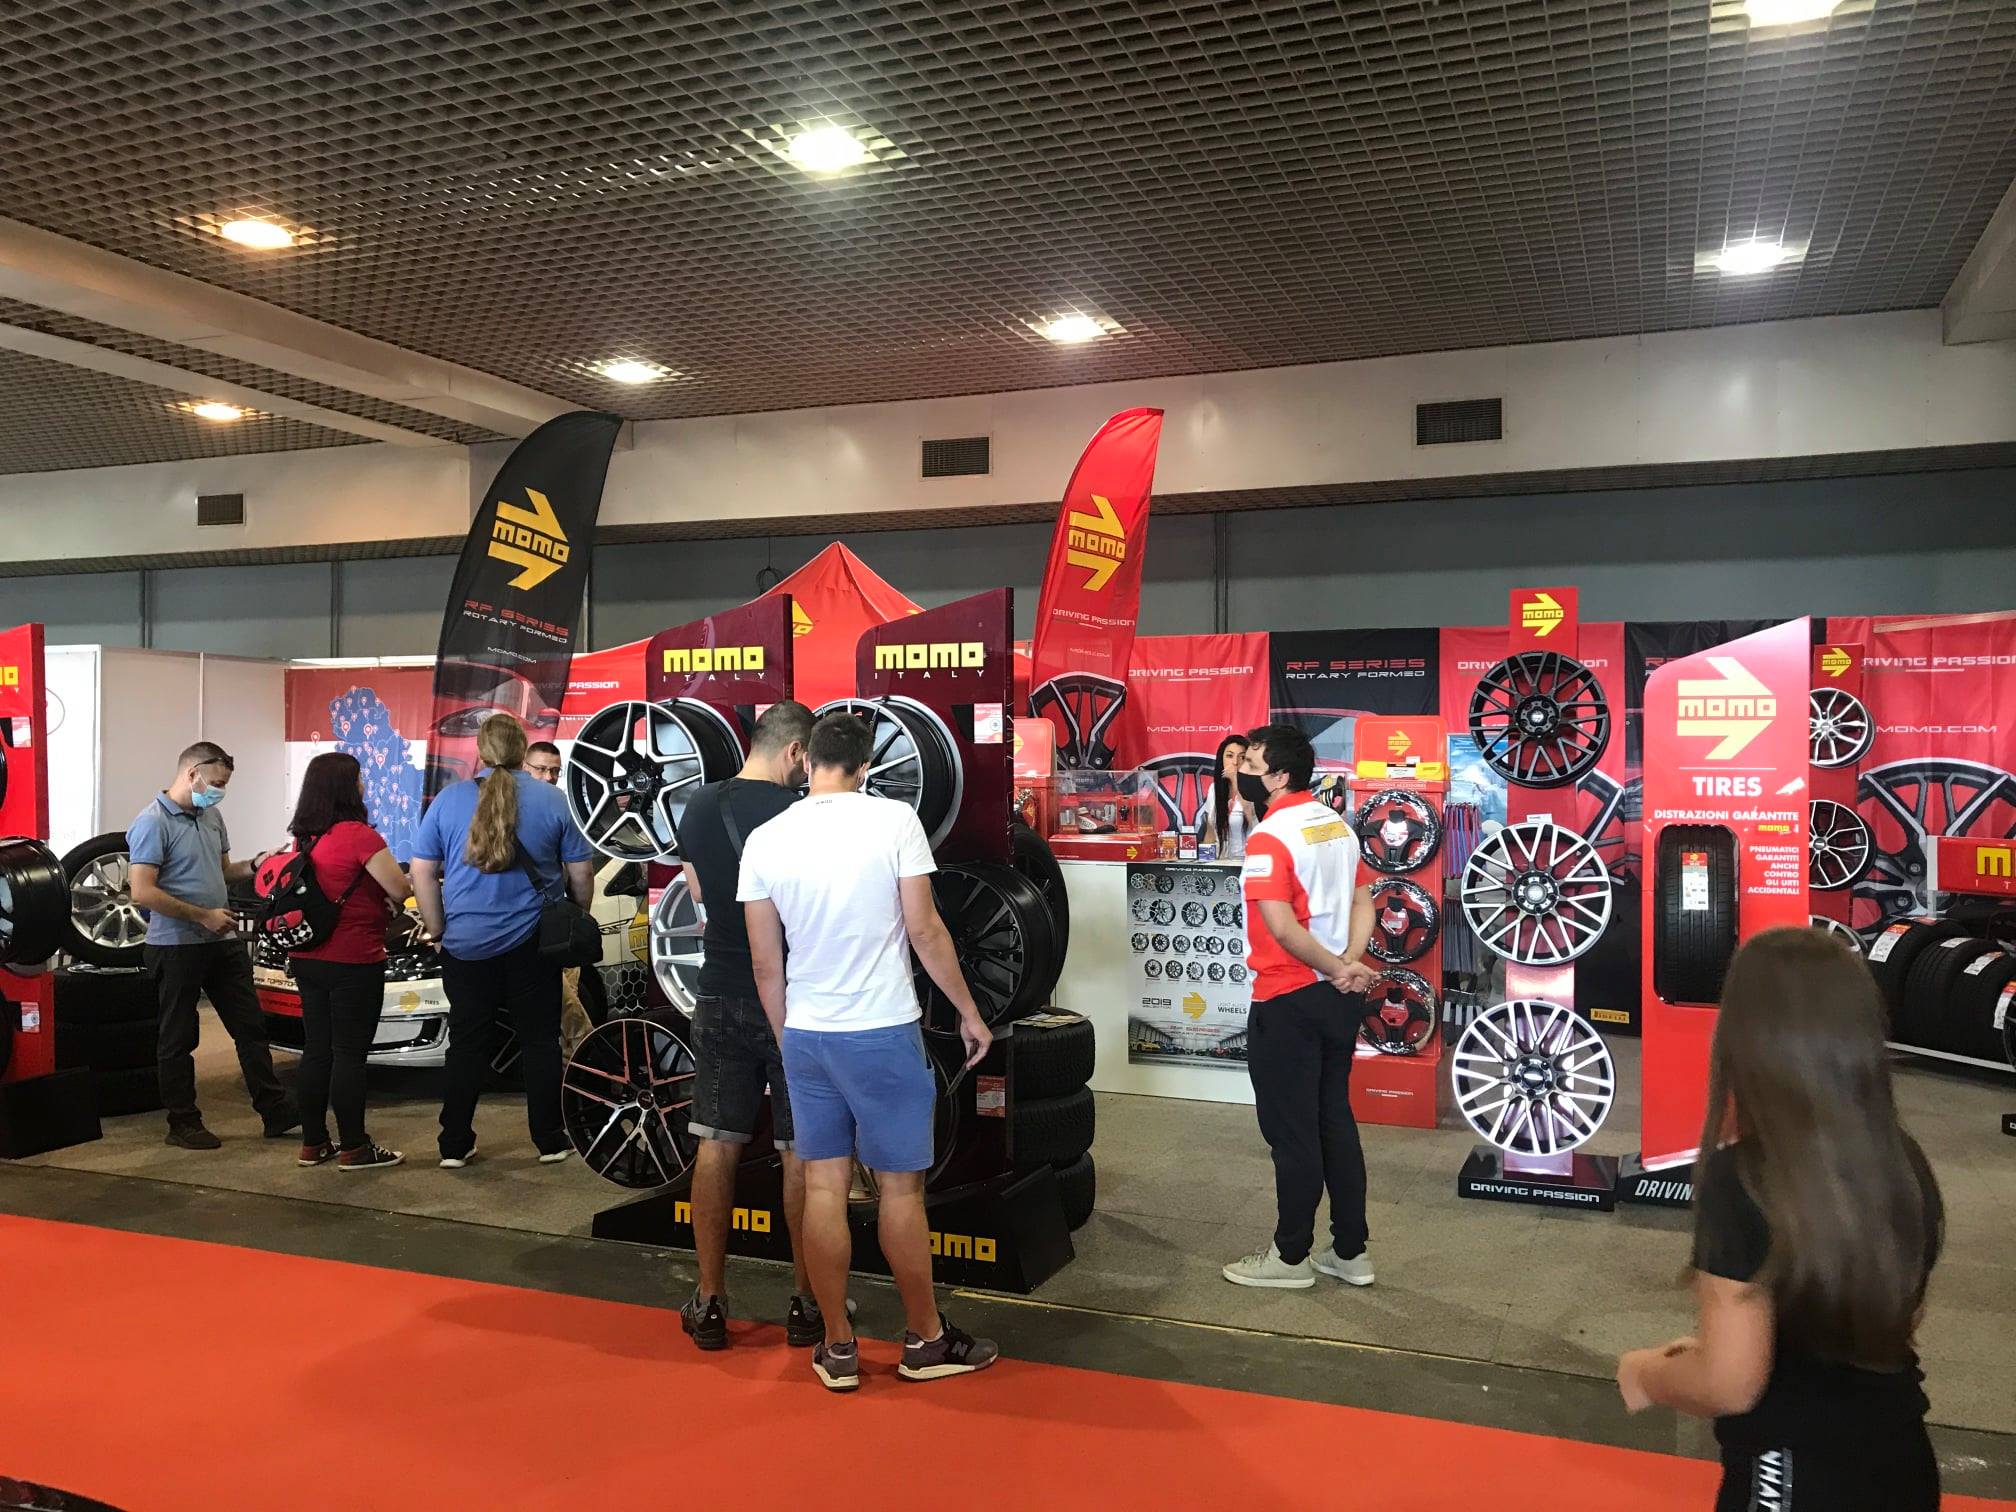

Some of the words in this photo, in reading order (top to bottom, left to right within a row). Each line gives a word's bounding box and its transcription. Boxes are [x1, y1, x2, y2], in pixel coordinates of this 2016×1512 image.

[1053, 608, 1090, 621] DRIVING
[1092, 615, 1135, 627] PASSION
[463, 610, 517, 627] ROTARY
[519, 625, 568, 644] FORMED
[1286, 660, 1320, 670] RF
[1329, 658, 1425, 670] SERIES
[1862, 657, 1927, 667] RIVING
[874, 670, 984, 680] ITALY
[1128, 667, 1184, 677] DRIVING
[1188, 665, 1253, 676] PASSION
[1286, 672, 1351, 680] ROTARY
[1357, 670, 1425, 679] FORMED
[663, 672, 765, 683] ITALY
[569, 681, 620, 690] PASSION
[1147, 724, 1233, 733] MOMO.COM
[1877, 725, 1998, 733] MOMO.COM
[1692, 776, 1763, 797] TIRES
[1654, 809, 1729, 820] DISTRAZIONI
[1733, 810, 1799, 821] GARANTITE
[1749, 845, 1799, 853] PNEUMATICI
[1763, 870, 1799, 878] CONTRO
[1142, 997, 1172, 1006] 2019
[1217, 1006, 1248, 1014] WHEELS
[1470, 1182, 1529, 1196] DRIVING
[1533, 1188, 1600, 1203] PASSION
[1635, 1179, 1696, 1201] DRIVIN
